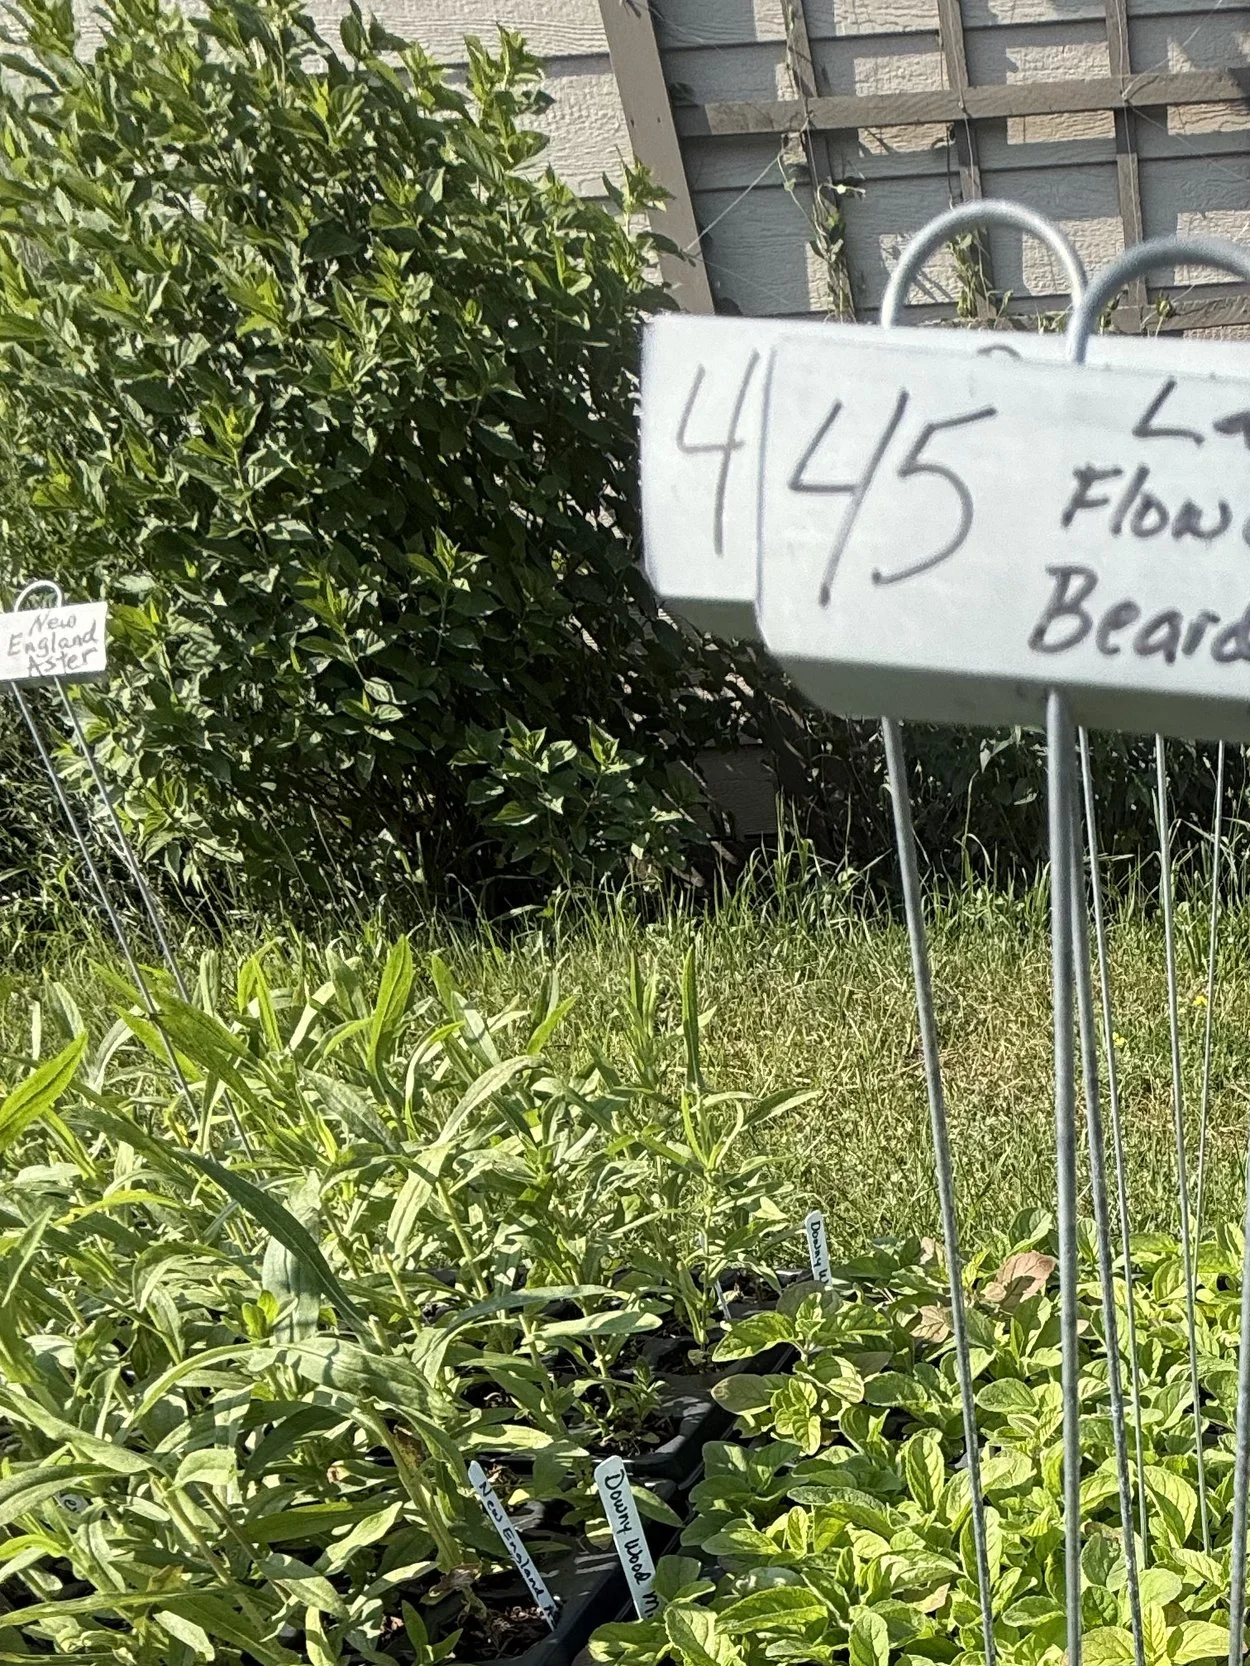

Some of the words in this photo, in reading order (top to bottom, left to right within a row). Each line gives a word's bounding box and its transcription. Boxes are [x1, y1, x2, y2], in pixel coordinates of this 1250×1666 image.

[786, 390, 999, 607] 45
[7, 619, 99, 659] England
[28, 612, 77, 637] New
[27, 646, 99, 678] Aster
[810, 1220, 822, 1268] Downy
[477, 1481, 503, 1523] New
[502, 1527, 544, 1598] England
[604, 1468, 633, 1535] Downy
[624, 1537, 652, 1586] Wood
